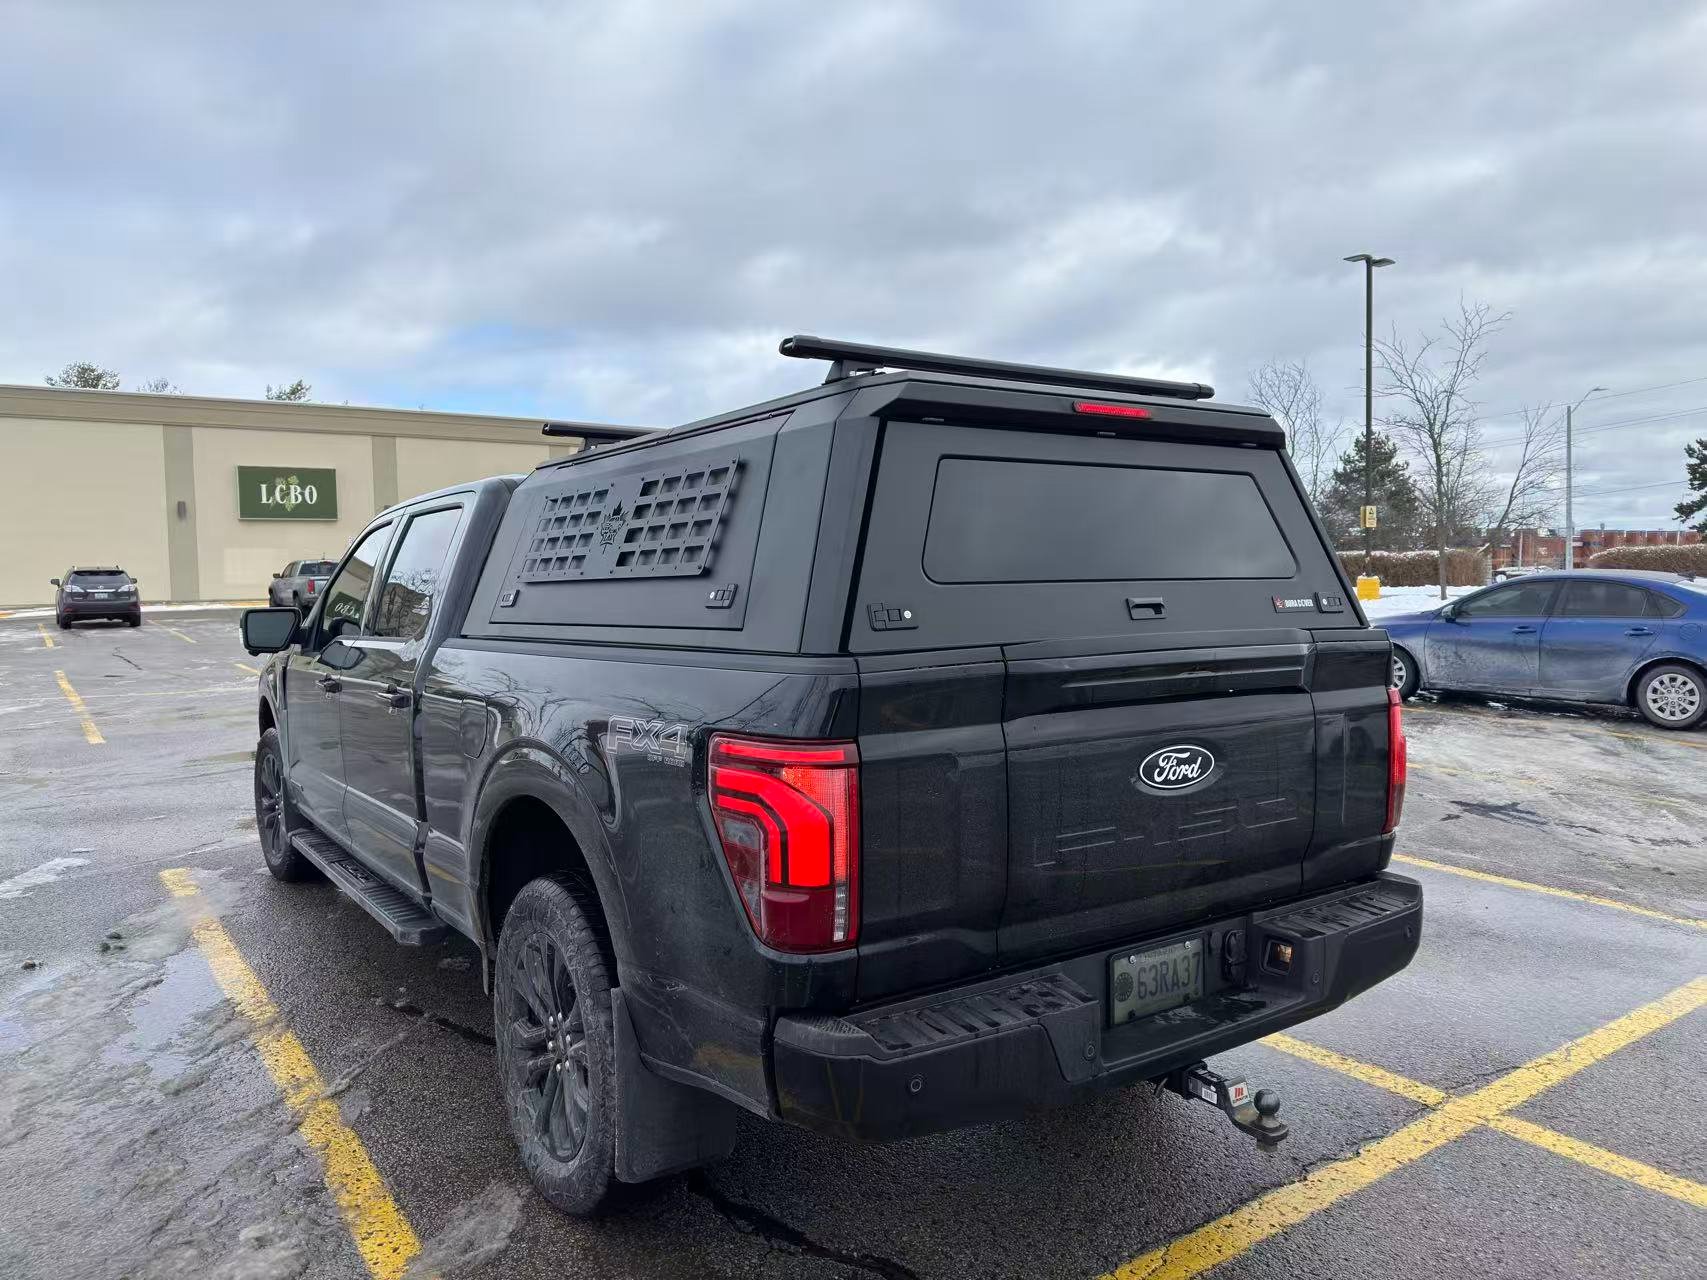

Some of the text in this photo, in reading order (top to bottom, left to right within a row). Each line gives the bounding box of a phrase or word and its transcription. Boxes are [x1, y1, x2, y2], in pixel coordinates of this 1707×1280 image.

[260, 484, 317, 504] LCBO
[606, 715, 688, 758] FX4
[1154, 752, 1202, 782] Ford
[1137, 952, 1200, 999] 63RA37
